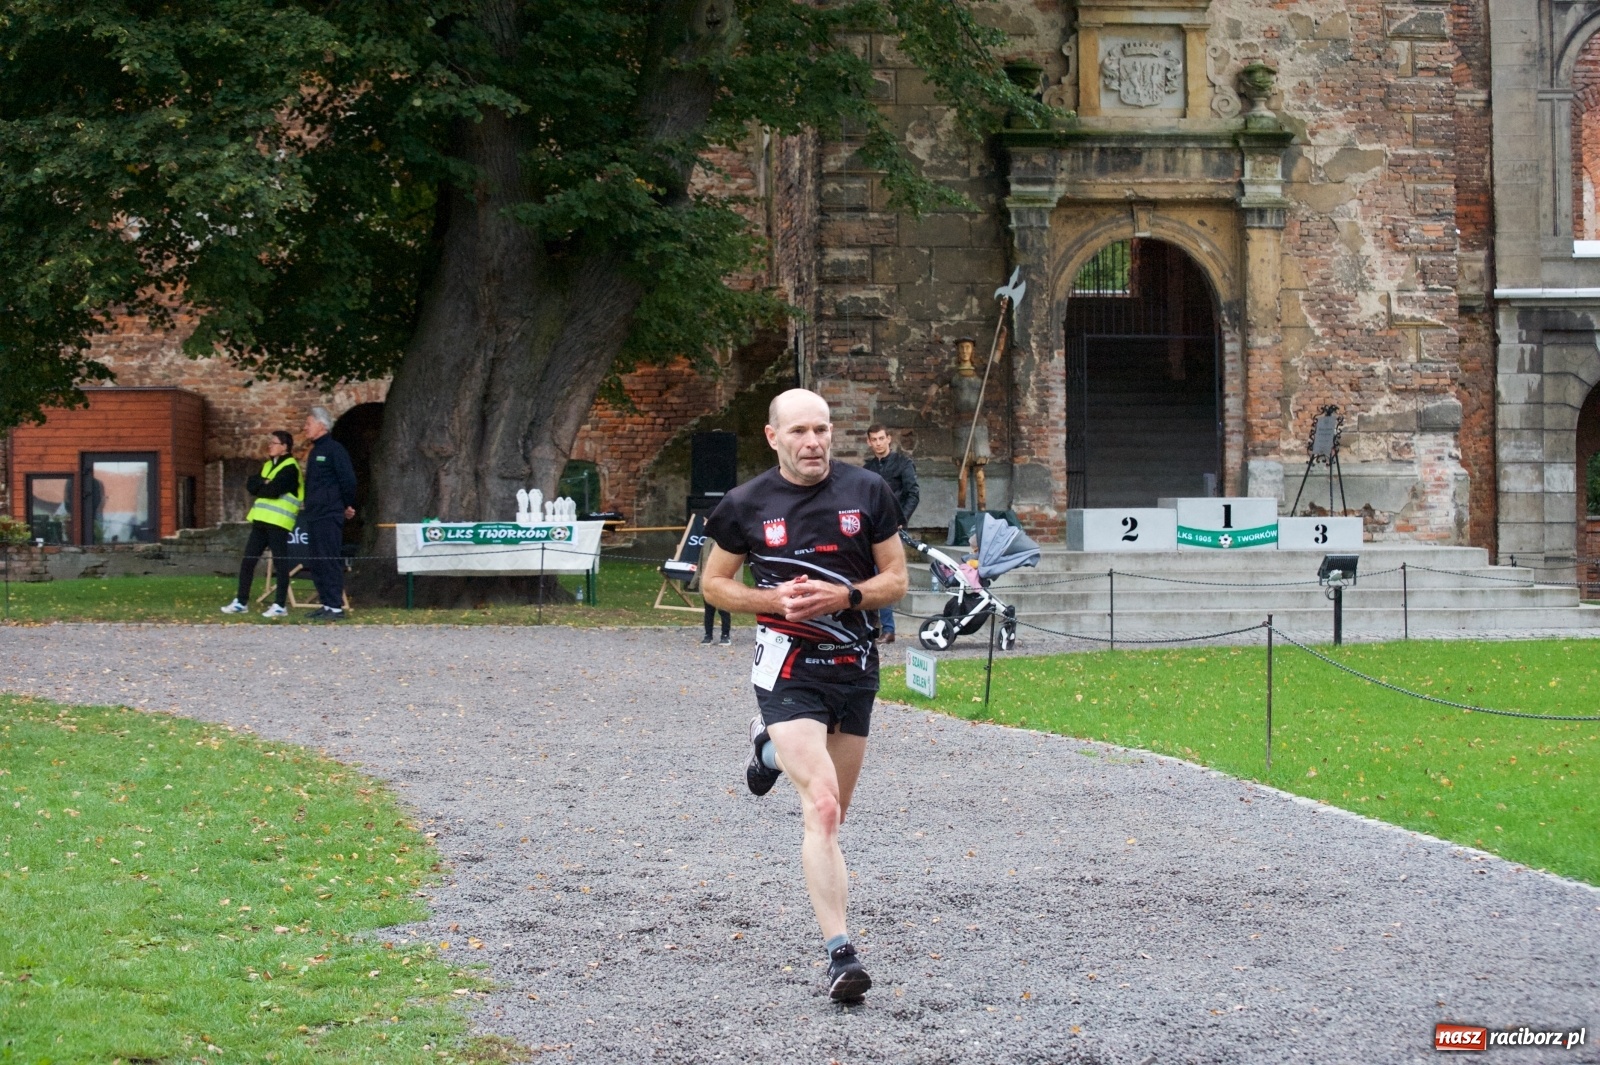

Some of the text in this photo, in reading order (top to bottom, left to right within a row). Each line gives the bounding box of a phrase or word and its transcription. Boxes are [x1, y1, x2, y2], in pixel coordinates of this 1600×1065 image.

[763, 517, 785, 525] POLSKA
[1222, 504, 1233, 528] 1
[447, 526, 548, 539] LKS TWORKÓW
[1121, 516, 1139, 542] 2
[1177, 529, 1277, 543] LKS 1905 TWORKÓW
[1314, 524, 1328, 544] 3
[912, 655, 928, 672] SZANUJ
